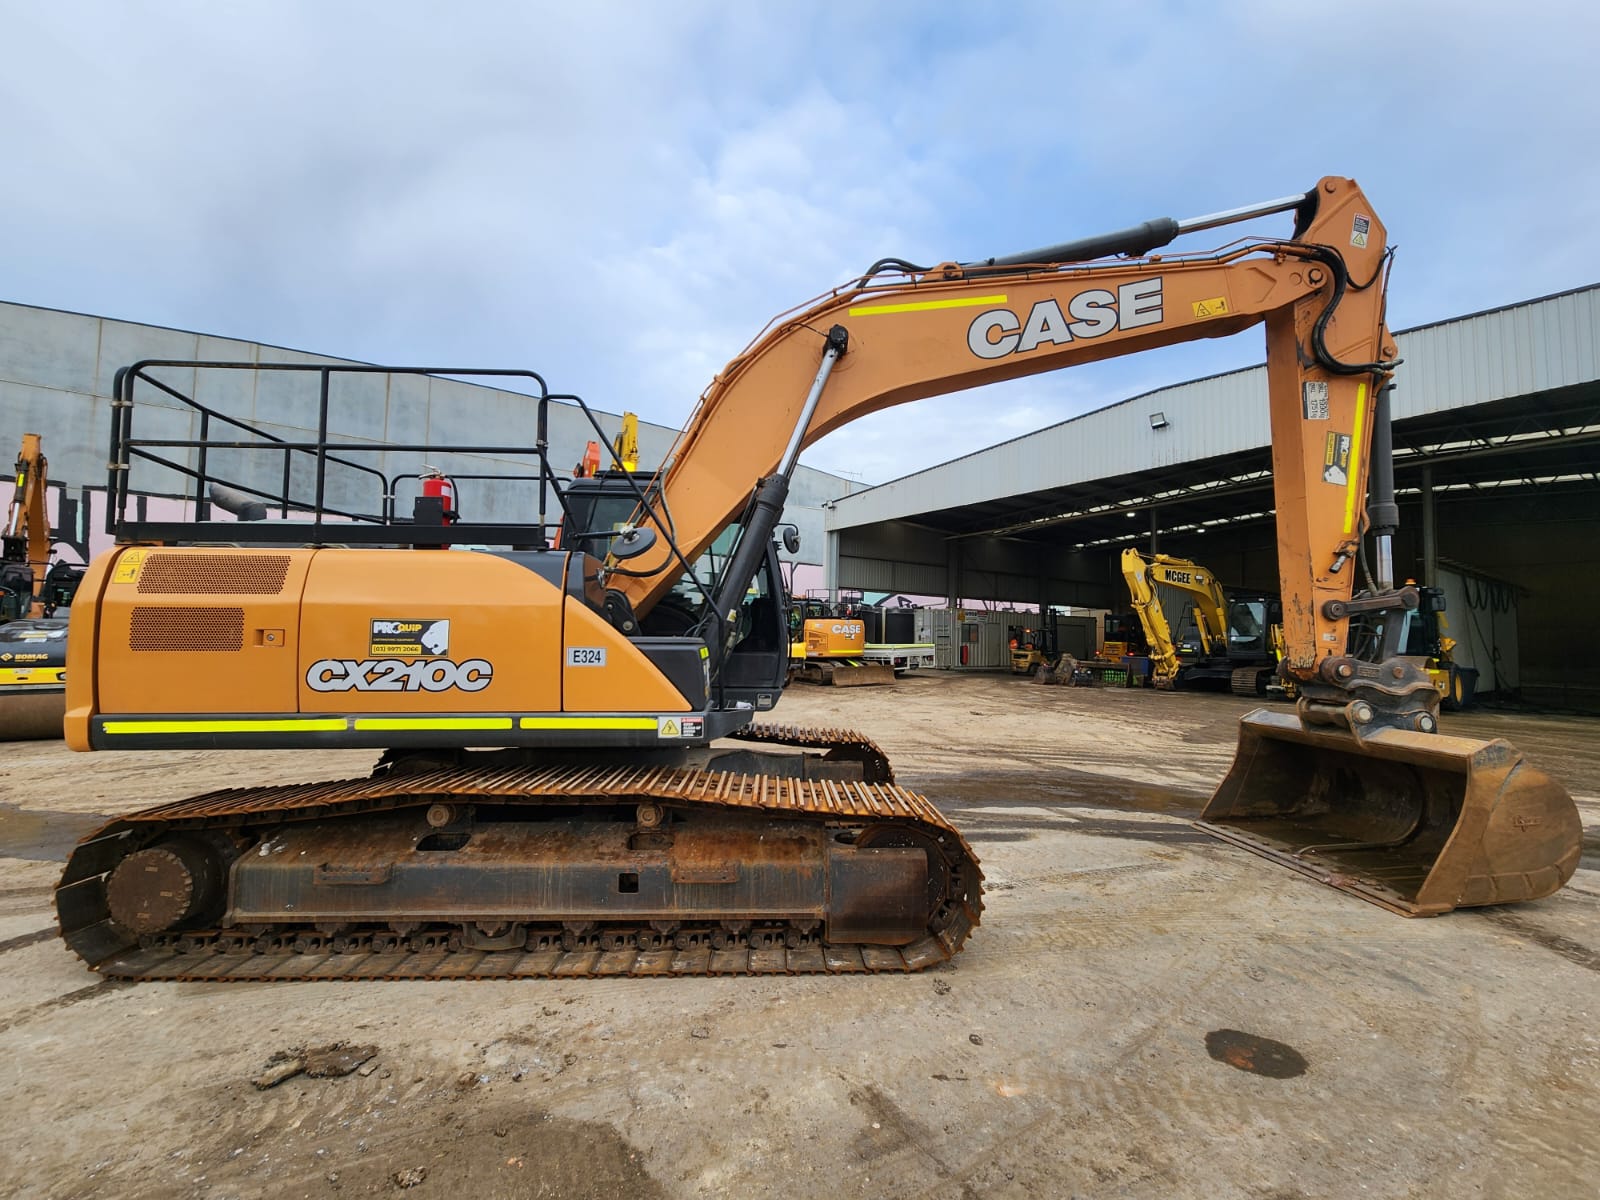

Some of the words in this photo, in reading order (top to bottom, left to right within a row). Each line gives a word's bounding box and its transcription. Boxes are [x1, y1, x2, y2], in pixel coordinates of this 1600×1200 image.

[966, 276, 1163, 360] CASE
[1165, 570, 1191, 584] MCGEE
[832, 624, 861, 634] CASE
[573, 650, 601, 663] E324
[305, 658, 494, 692] CX210C
